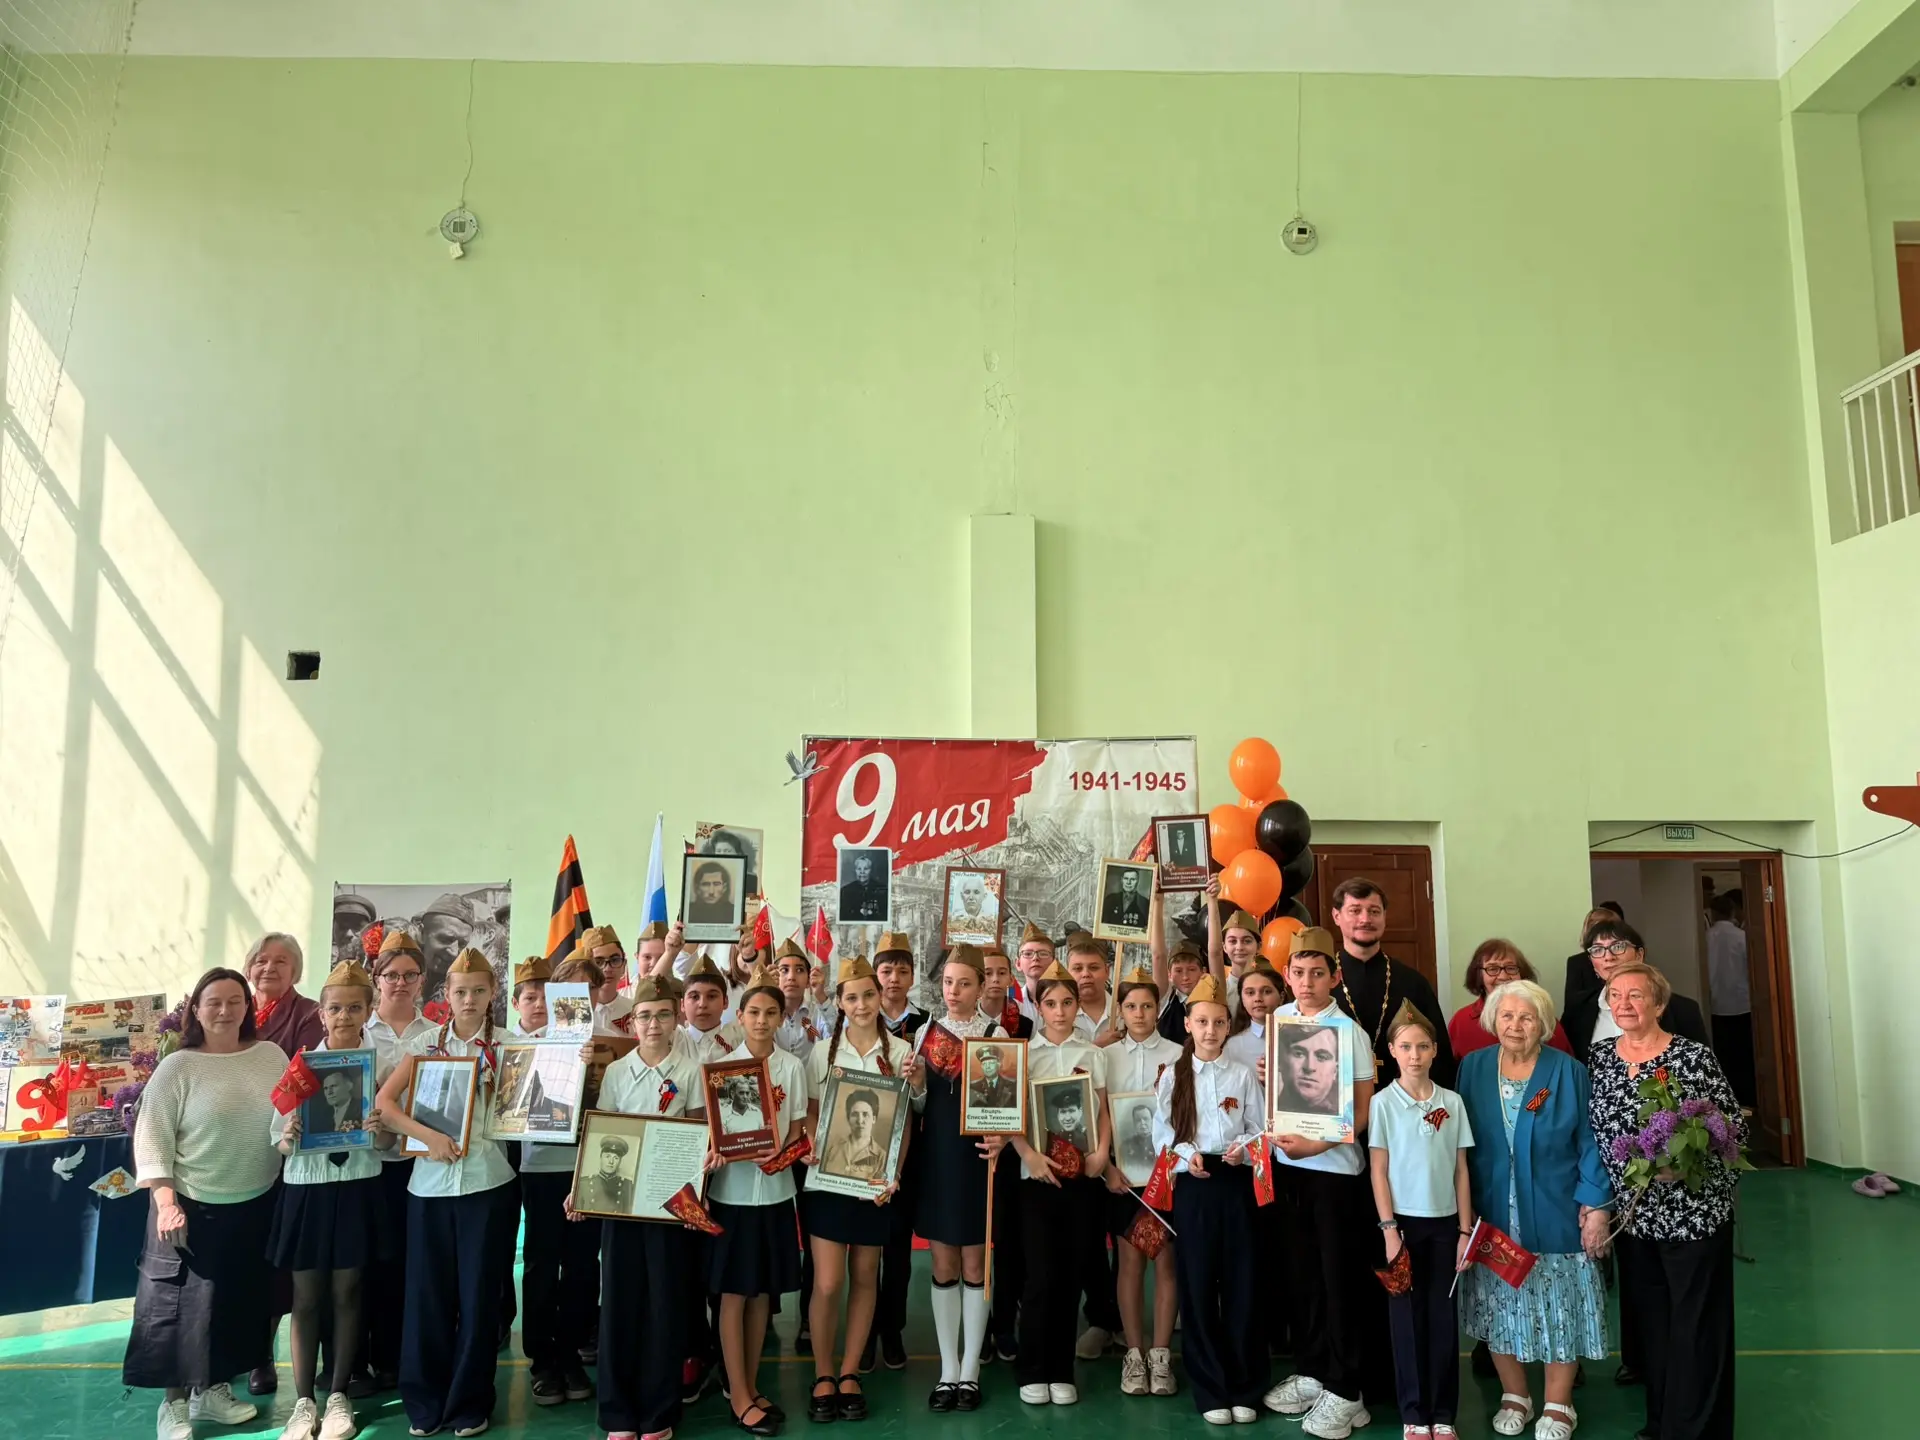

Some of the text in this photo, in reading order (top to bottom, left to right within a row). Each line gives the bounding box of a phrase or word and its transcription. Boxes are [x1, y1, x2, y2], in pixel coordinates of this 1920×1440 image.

[1069, 771, 1187, 791] 1941-1945
[832, 752, 991, 848] 9 мая
[1667, 828, 1694, 839] ВЫХОД
